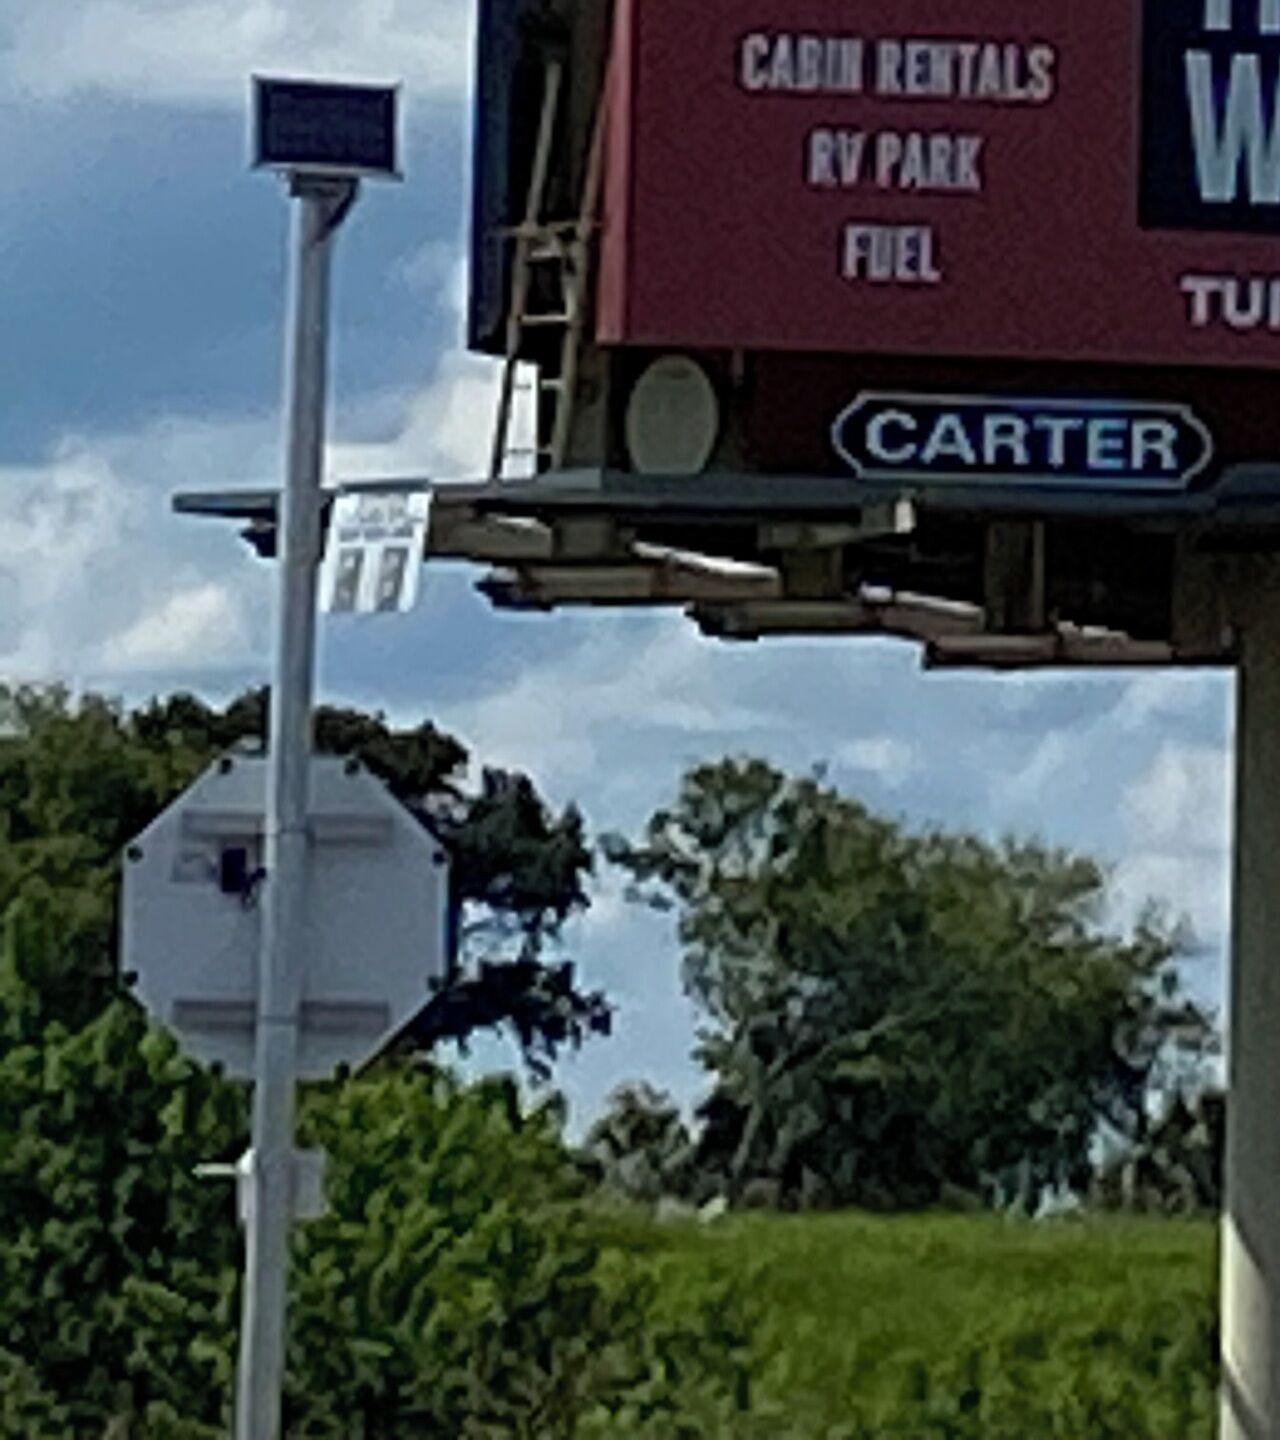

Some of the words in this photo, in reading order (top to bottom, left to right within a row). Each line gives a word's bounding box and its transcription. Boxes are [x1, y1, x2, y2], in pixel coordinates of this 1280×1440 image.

[741, 33, 863, 92] CABIN
[875, 39, 1055, 102] RENTALS
[808, 128, 866, 186] RV
[875, 131, 983, 191] PARK
[841, 224, 943, 283] FUEL
[865, 409, 1178, 471] CARTER
